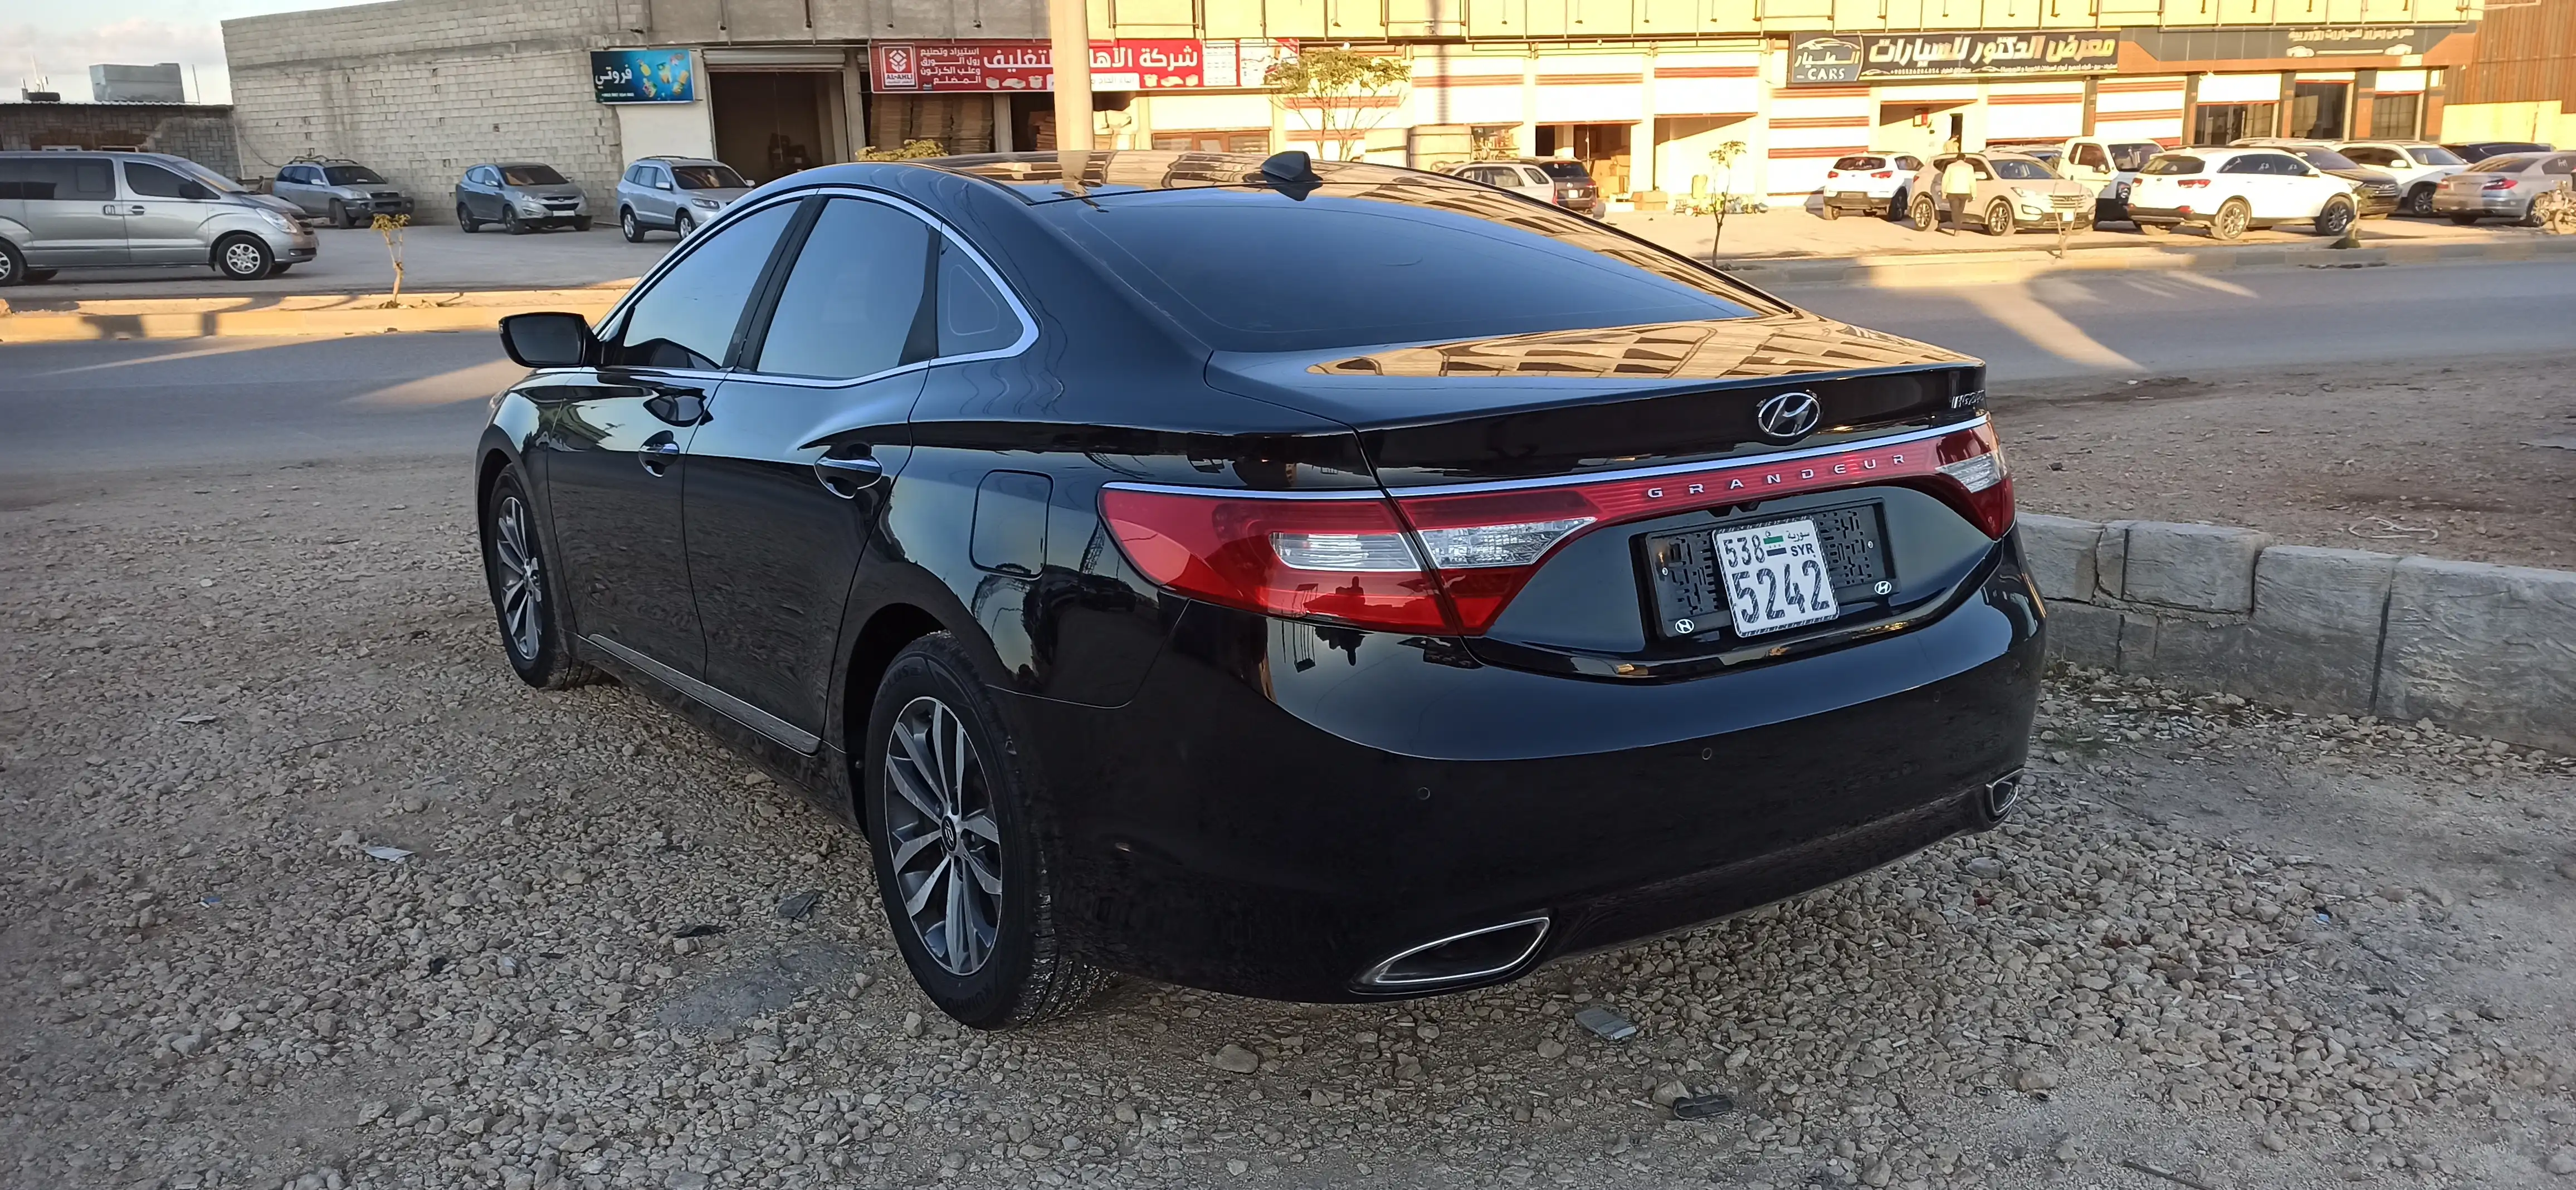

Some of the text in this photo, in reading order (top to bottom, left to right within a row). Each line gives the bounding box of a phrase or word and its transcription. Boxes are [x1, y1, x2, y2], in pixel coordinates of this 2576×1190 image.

[920, 47, 979, 57] استيراد وتصنيع
[1869, 35, 2115, 67] معرض الدكتور للسيارات
[967, 57, 980, 66] رول
[984, 45, 1197, 72] شركة الأهل لتغليف
[595, 64, 632, 89] فروتي
[920, 66, 980, 76] وعلب الكرتون
[1807, 67, 1845, 80] CARS
[933, 76, 982, 85] المضلع
[1647, 455, 1906, 498] GRANDEUR
[1785, 530, 1811, 542] سورية
[1723, 534, 1765, 568] 538
[1790, 543, 1815, 557] SYR
[1731, 559, 1830, 623] 5242
